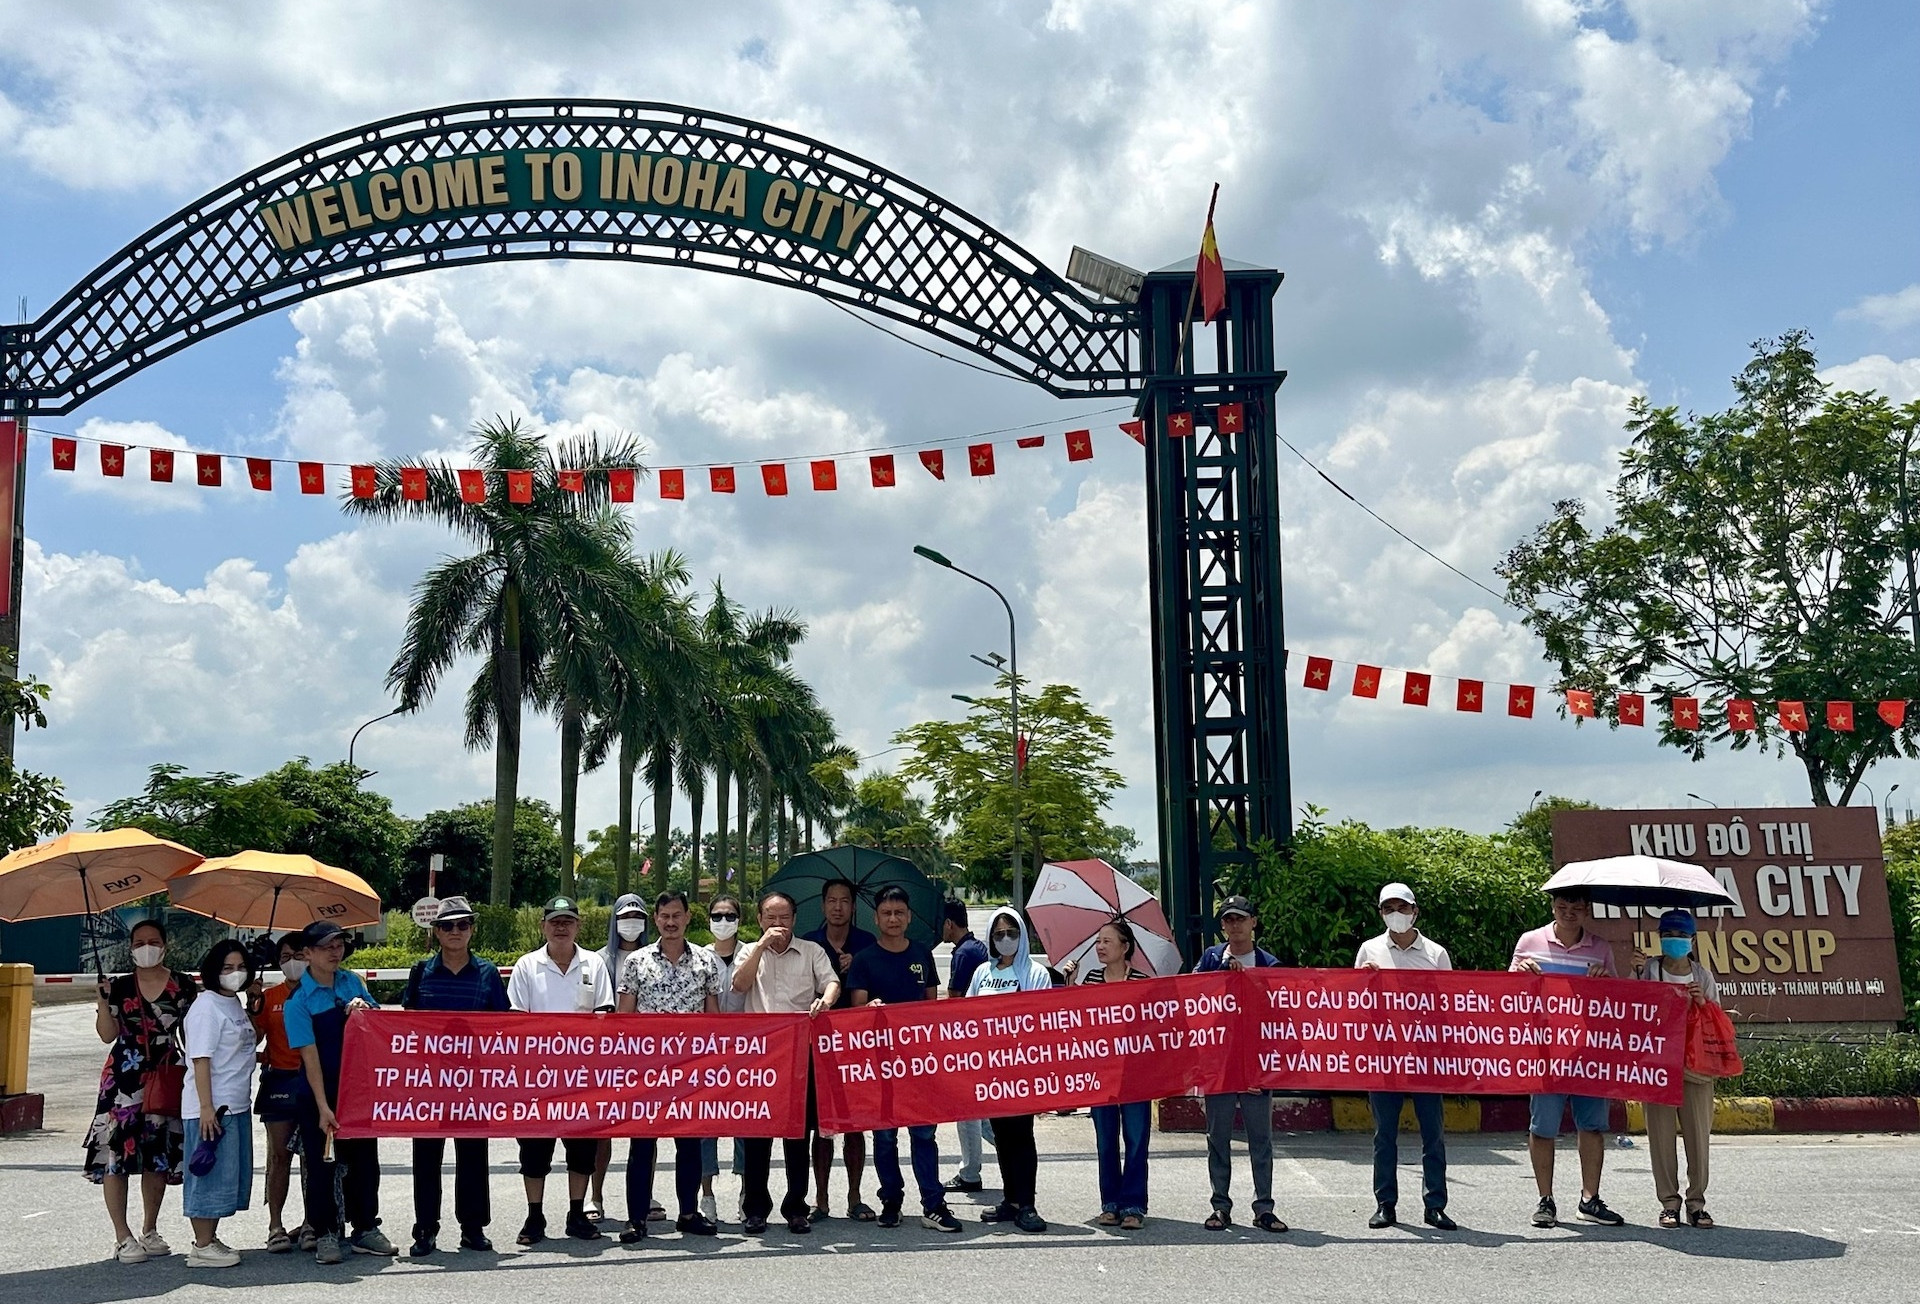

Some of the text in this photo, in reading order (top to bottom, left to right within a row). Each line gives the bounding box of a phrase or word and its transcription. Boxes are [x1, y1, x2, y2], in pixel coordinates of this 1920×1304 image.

[260, 151, 871, 251] WELCOME TO INOHA CITY
[1629, 815, 1814, 862] KHU ĐÔ THỊ
[103, 874, 142, 891] FWD
[1755, 864, 1863, 917] CITY
[317, 903, 347, 916] FWD
[980, 977, 1019, 989] Chillers
[1822, 977, 1843, 995] PHỐ
[1847, 978, 1862, 995] HÀ
[1267, 985, 1661, 1026] YÊU CẦU ĐỐI THOẠI 3 BÊN: GIỮA CHỦ ĐẦU TƯ,
[818, 992, 1242, 1054] ĐỀ NGHỊ CTY N&G THỰC HIỆN THEO HỢP ĐỒNG,
[1260, 1017, 1666, 1055] NHÀ ĐẦU TƯ VÀ VĂN PHÒNG ĐĂNG KÝ NHÀ ĐẤT
[391, 1030, 767, 1059] ĐỀ NGHỊ VĂN PHÒNG ĐĂNG KÝ ĐẤT ĐAI
[838, 1058, 877, 1084] TRẢ
[911, 1052, 939, 1076] ĐỎ
[943, 1051, 983, 1073] CHO
[988, 1042, 1052, 1069] KHÁCH
[1057, 1037, 1109, 1061] HÀNG
[1113, 1034, 1155, 1056] MUA
[1158, 1027, 1184, 1050] TỪ
[1188, 1026, 1227, 1048] 2017
[374, 1063, 777, 1093] TP HÀ NỘI TRẢ LỜI VỀ VIỆC CẤP 4 SỔ CHO
[1258, 1049, 1669, 1087] VỀ VẤN ĐỀ CHUYỂN NHƯỢNG CHO KHÁCH HÀNG
[975, 1072, 1101, 1102] ĐÓNG ĐỦ 95%
[372, 1096, 772, 1125] KHÁCH HÀNG ĐÃ MUA TẠI DỰ ÁN INNOHA
